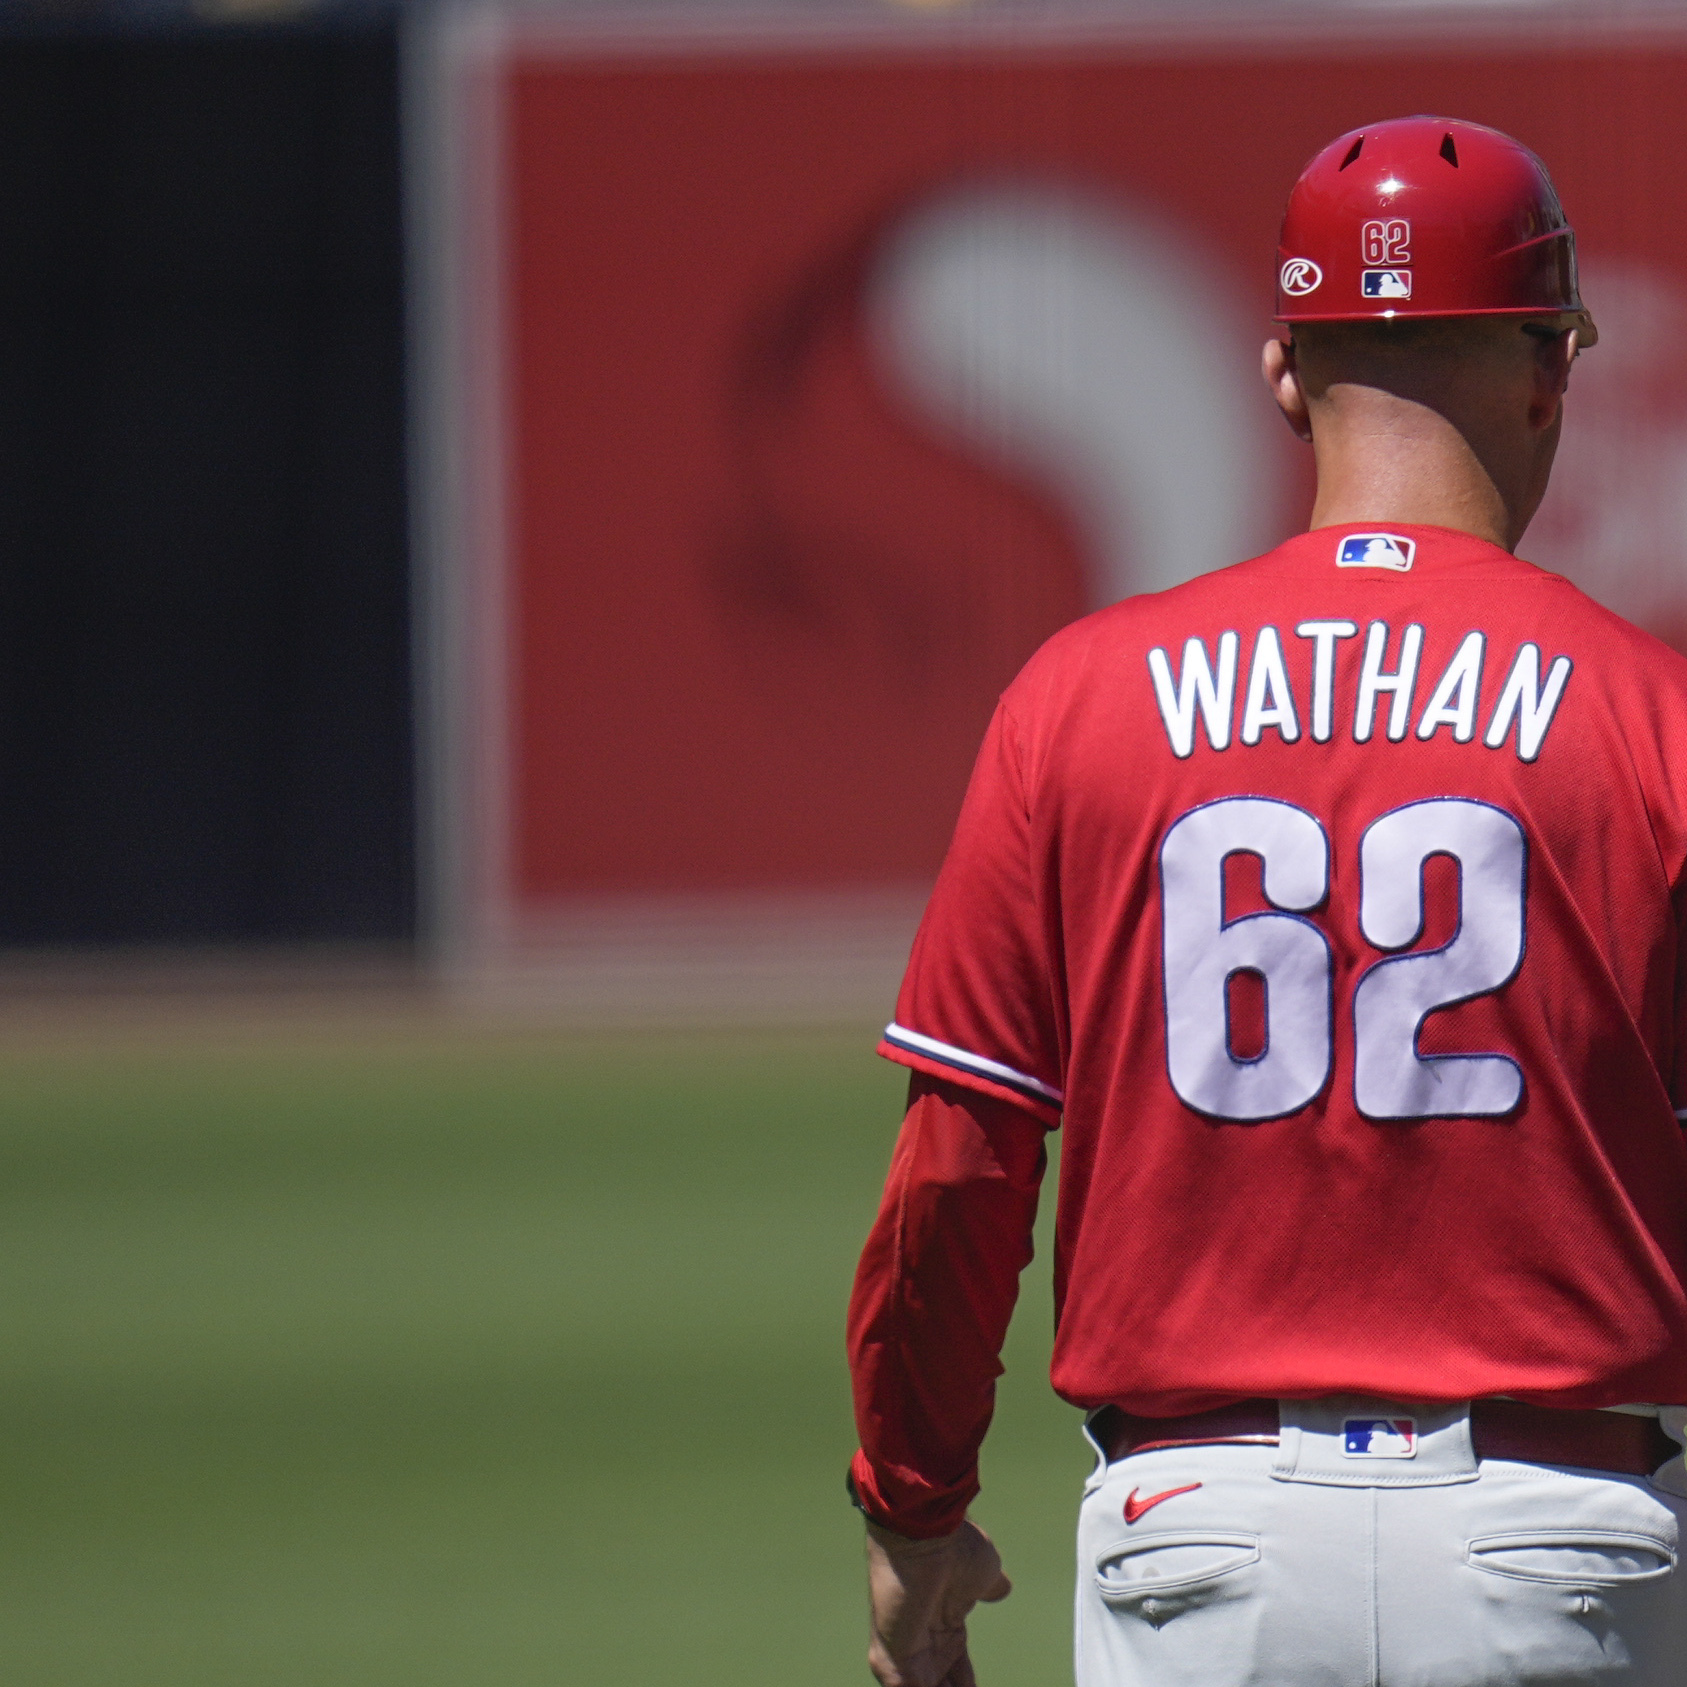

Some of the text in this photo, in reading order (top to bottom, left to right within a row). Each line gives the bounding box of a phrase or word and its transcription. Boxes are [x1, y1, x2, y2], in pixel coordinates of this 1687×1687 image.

[1361, 219, 1411, 266] 62
[1146, 618, 1573, 763] WATHAN
[1158, 793, 1529, 1122] 62
